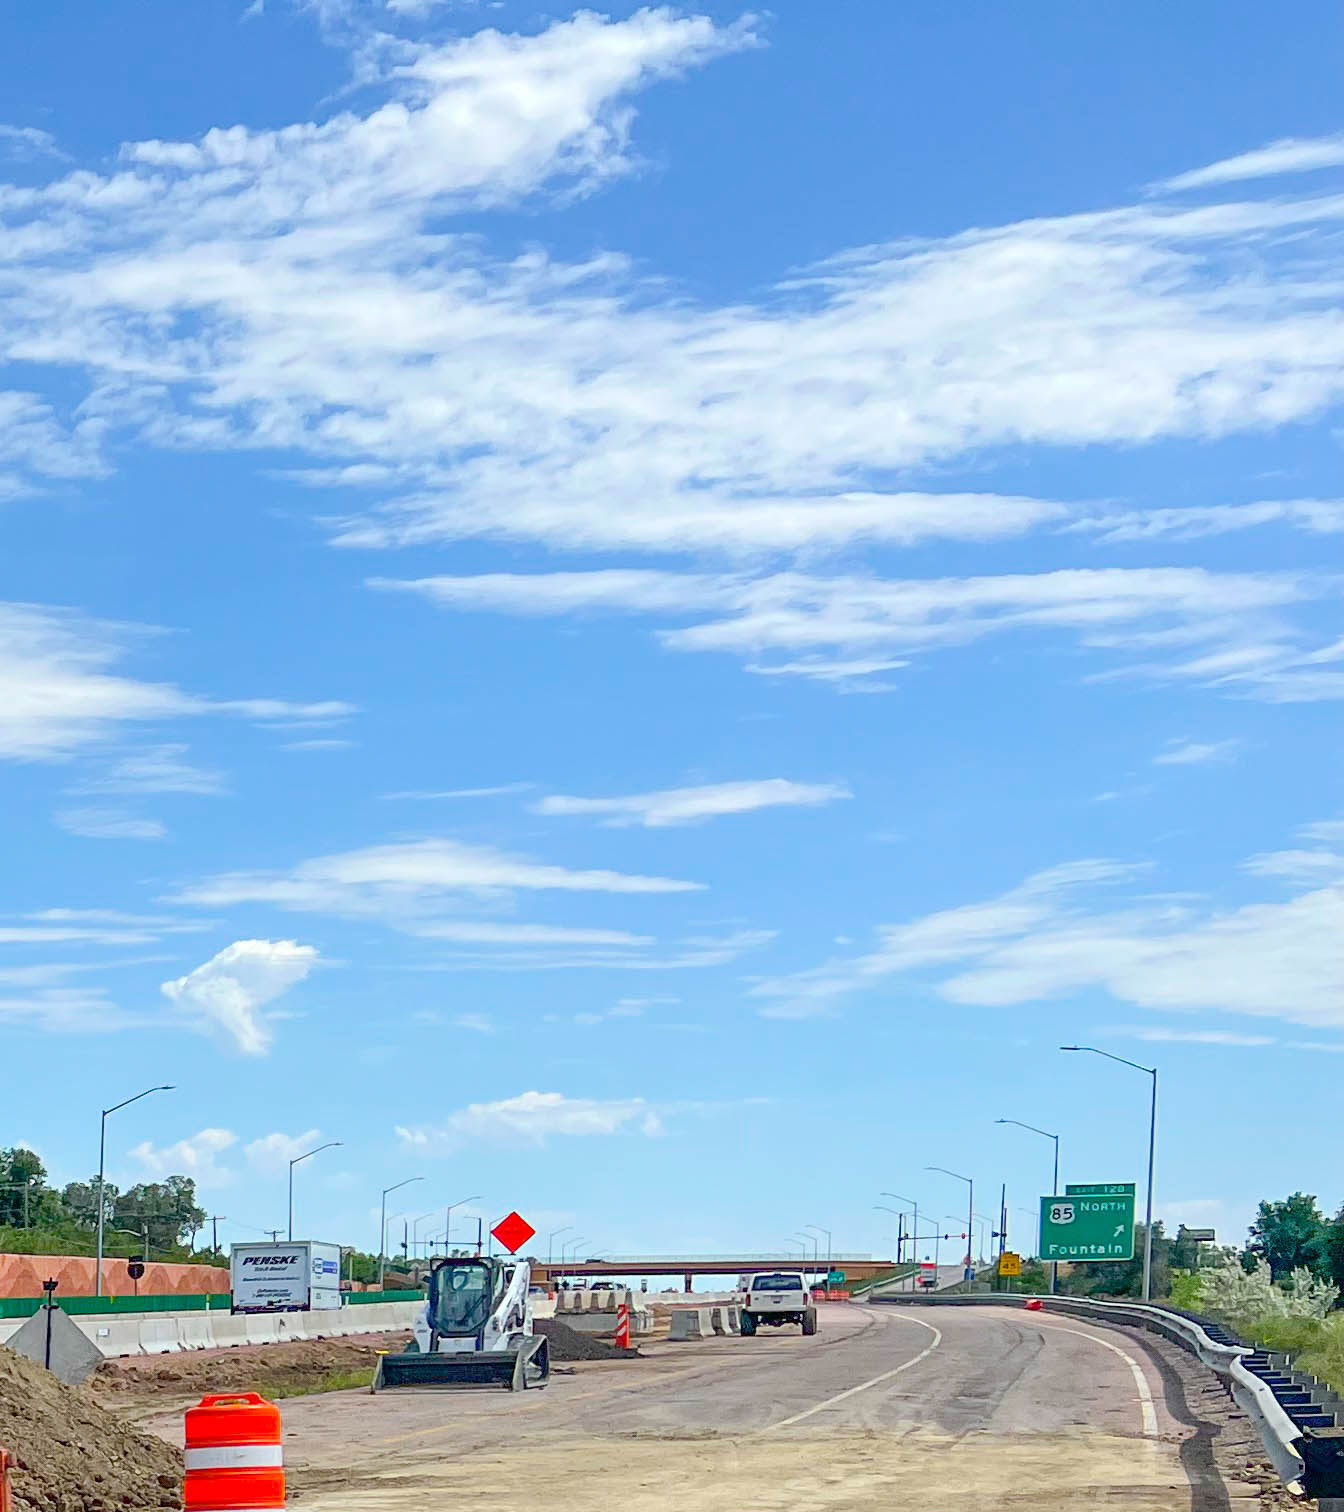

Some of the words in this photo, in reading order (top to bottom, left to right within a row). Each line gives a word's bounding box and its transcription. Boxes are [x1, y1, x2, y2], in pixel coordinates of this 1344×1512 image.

[1052, 1207, 1073, 1221] 85
[1049, 1244, 1123, 1254] Fountain
[242, 1256, 299, 1265] PENSKE
